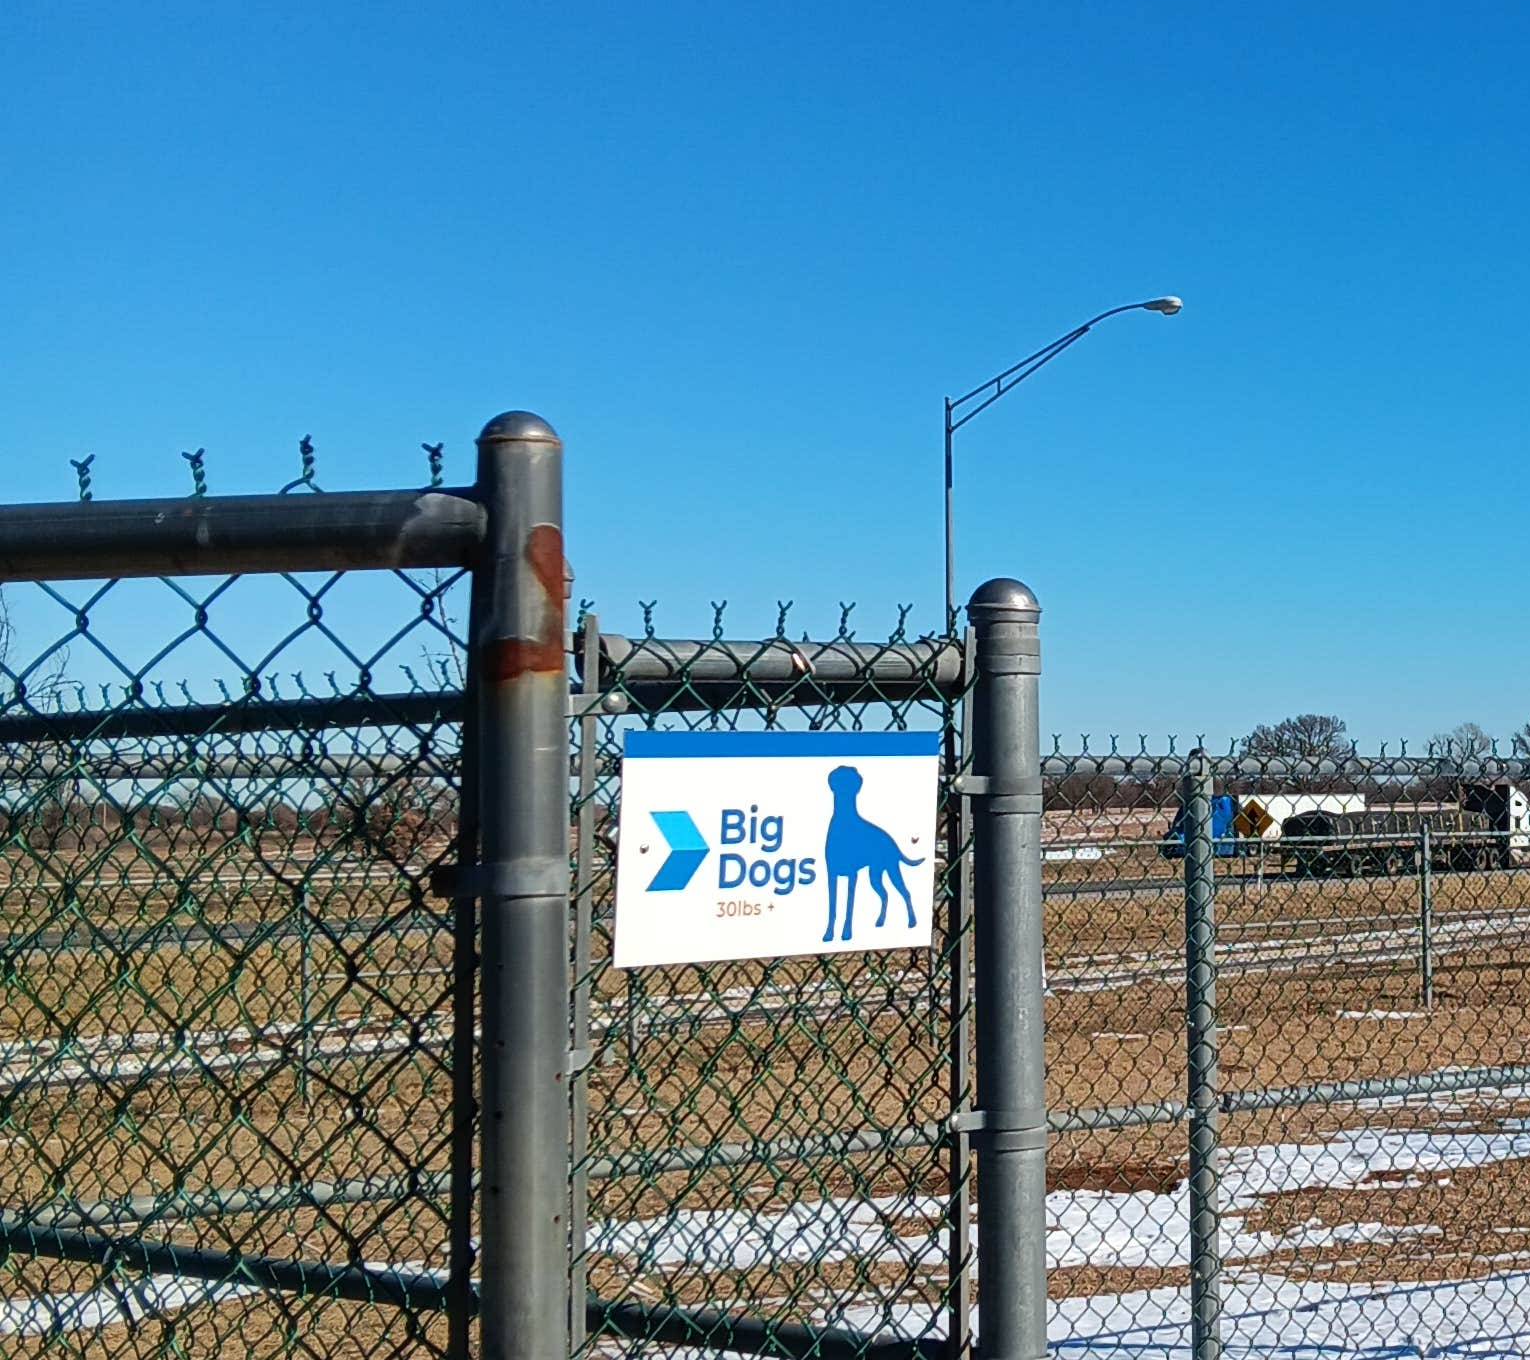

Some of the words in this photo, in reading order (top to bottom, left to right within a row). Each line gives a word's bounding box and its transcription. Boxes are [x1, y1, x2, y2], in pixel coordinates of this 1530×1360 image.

[719, 804, 784, 853] Big
[718, 852, 816, 895] Dogs
[716, 899, 762, 918] 30lbs
